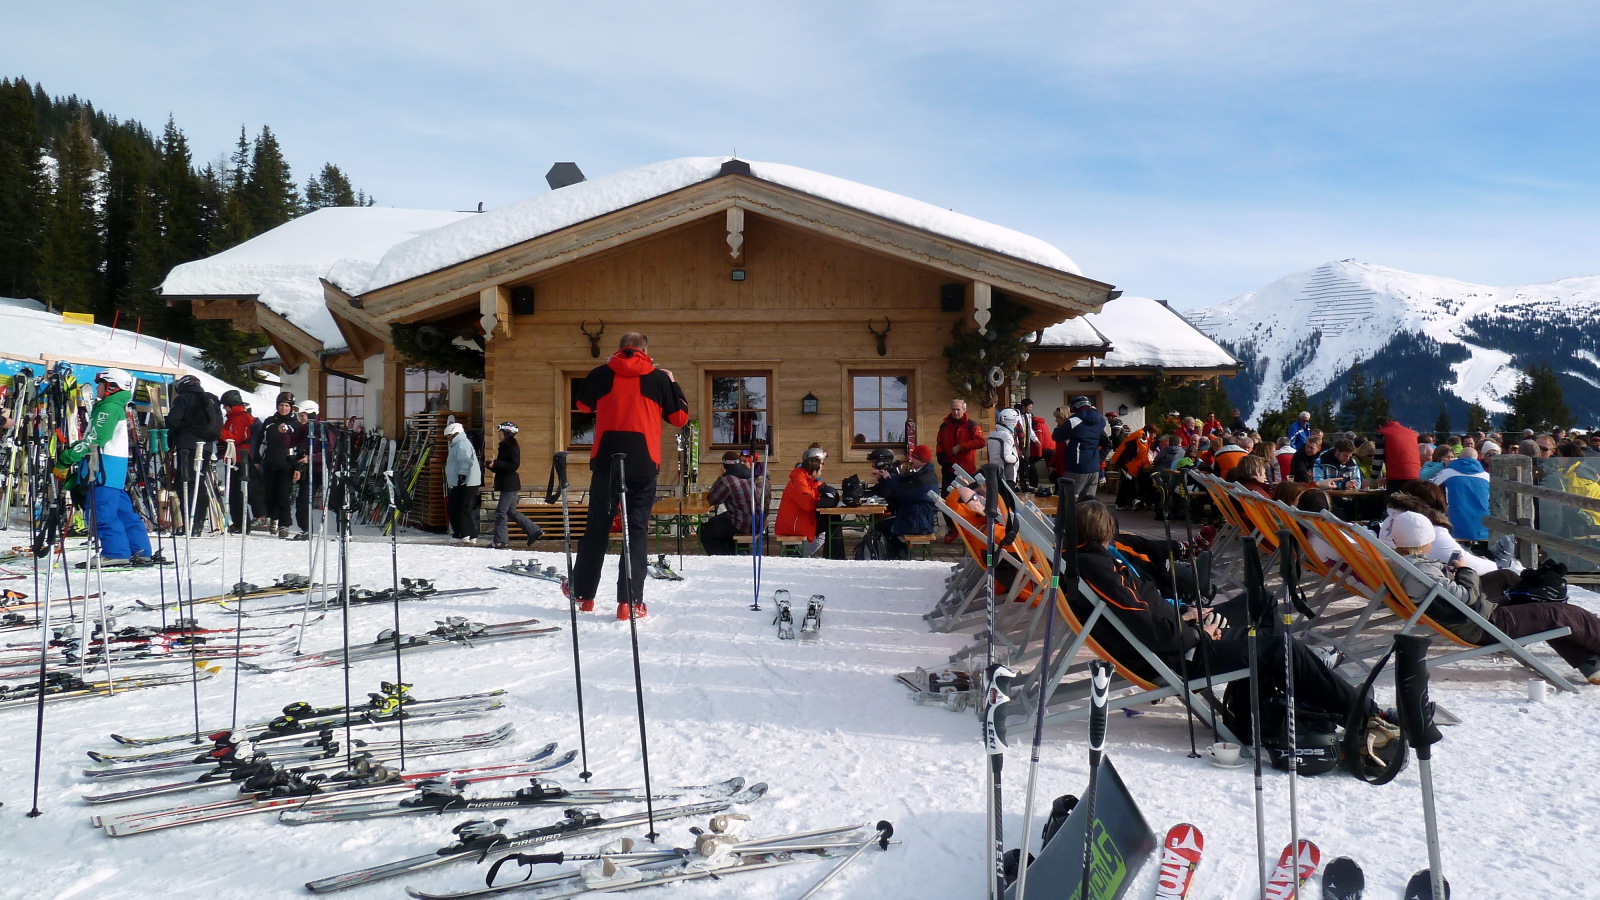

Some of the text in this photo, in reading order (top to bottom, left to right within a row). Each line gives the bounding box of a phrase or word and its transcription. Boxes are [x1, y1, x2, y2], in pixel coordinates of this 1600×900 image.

[987, 721, 996, 750] LEKI
[1280, 748, 1325, 757] SCOT
[467, 801, 519, 809] FIREBIRD
[509, 833, 561, 848] FIREBIRD
[995, 840, 1004, 878] LEKI
[1156, 847, 1190, 900] ATO
